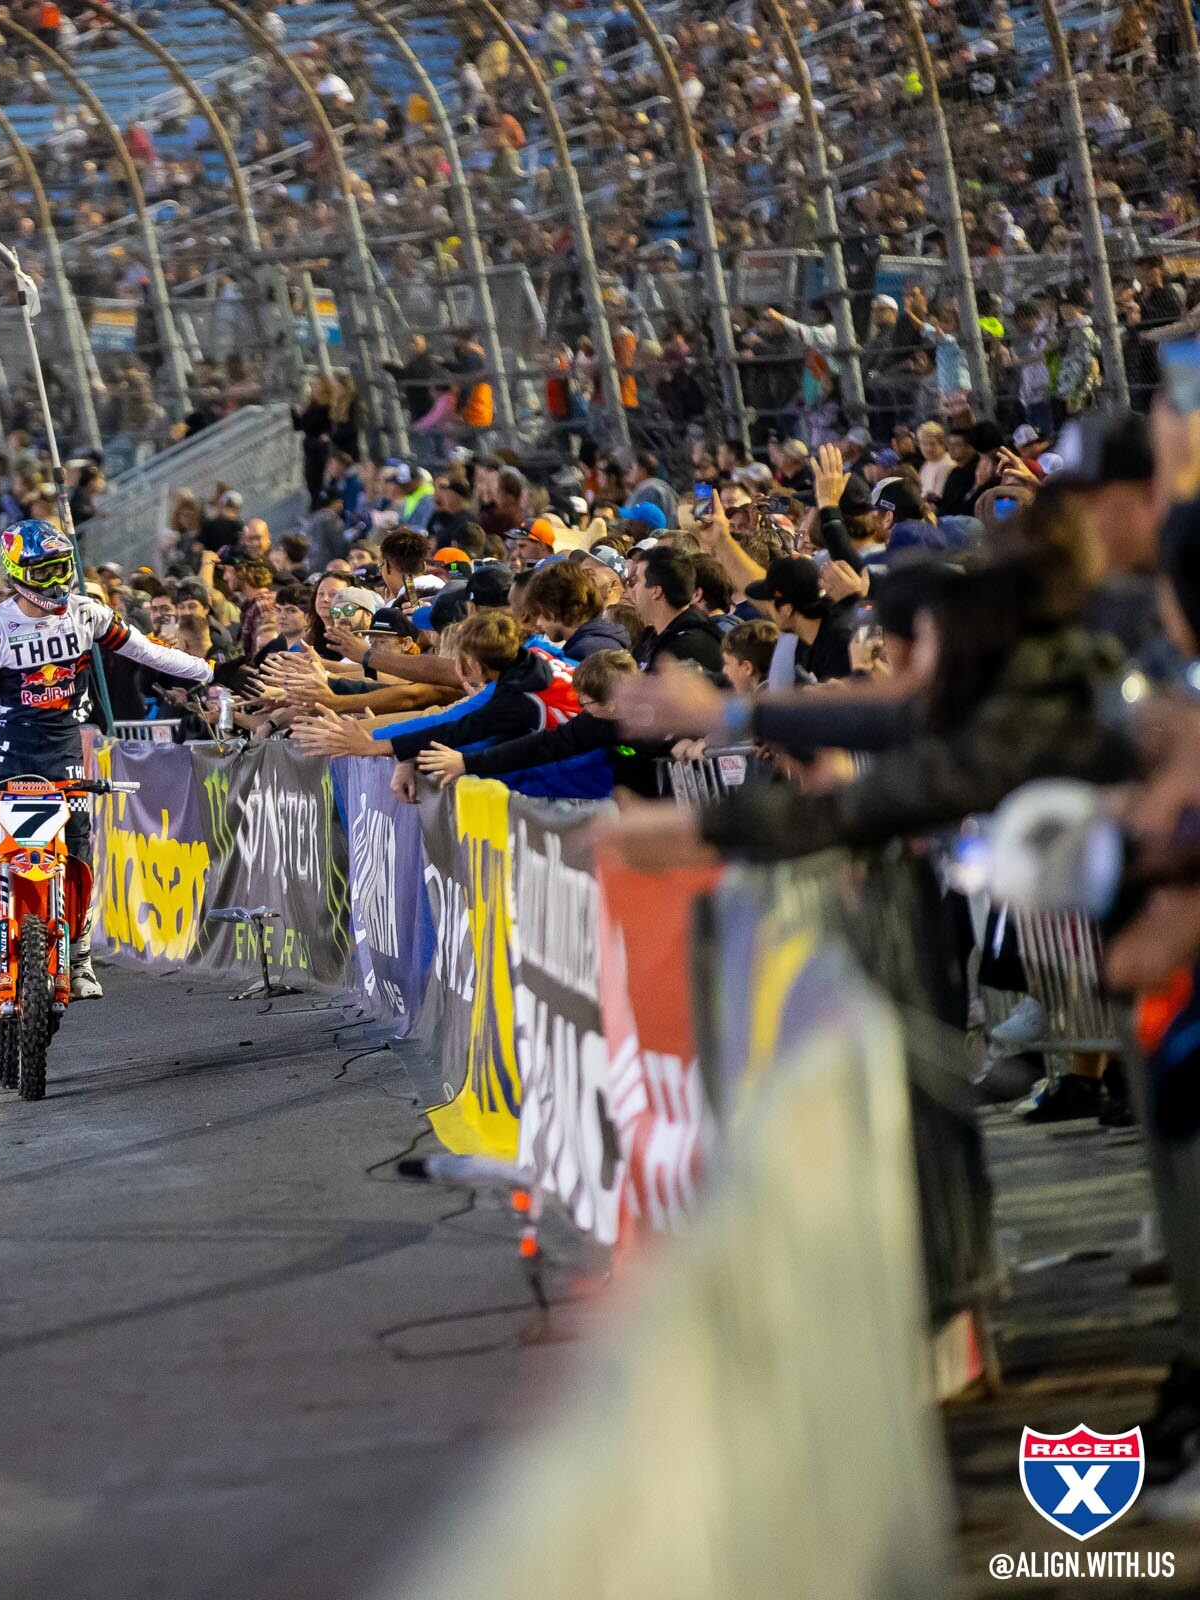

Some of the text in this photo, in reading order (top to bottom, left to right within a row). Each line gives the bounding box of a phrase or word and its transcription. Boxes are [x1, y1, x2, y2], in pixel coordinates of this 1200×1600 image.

[10, 632, 80, 666] THOR
[21, 687, 53, 705] Red
[65, 765, 86, 779] TH
[11, 803, 62, 839] 7
[0, 930, 8, 973] DUNOP
[57, 924, 65, 967] DUNLP
[235, 922, 313, 969] ENER
